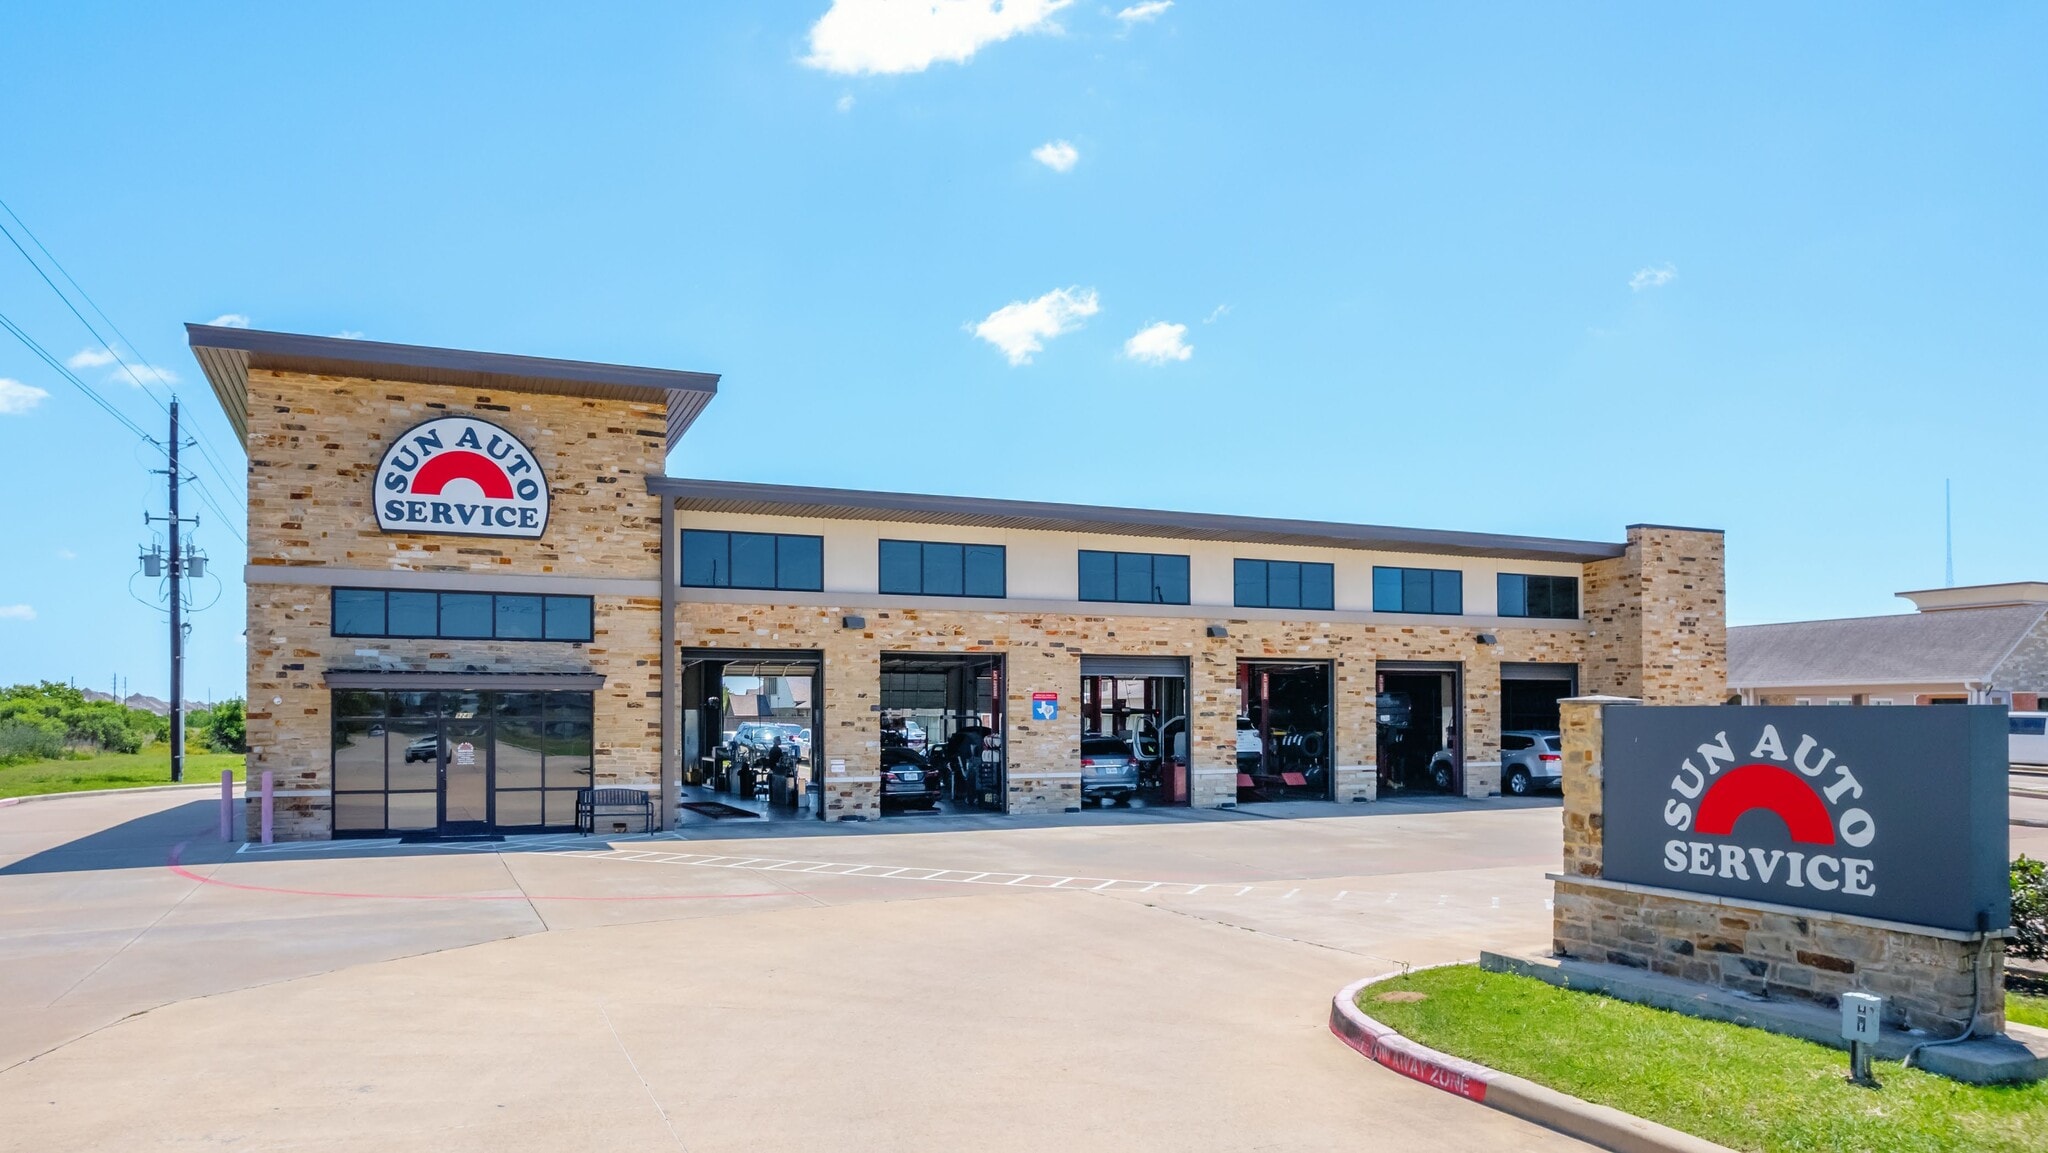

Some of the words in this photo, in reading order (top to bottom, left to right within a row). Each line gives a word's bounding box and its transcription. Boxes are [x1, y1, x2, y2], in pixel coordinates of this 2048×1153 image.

[384, 428, 444, 494] SUN
[455, 426, 539, 501] AUTO
[384, 499, 539, 529] SERVICE
[1664, 730, 1735, 831] SUN
[1750, 724, 1876, 848] AUTO
[1664, 839, 1876, 897] SERVICE
[1393, 1050, 1427, 1078] AWAY
[1430, 1066, 1470, 1096] ZONE
